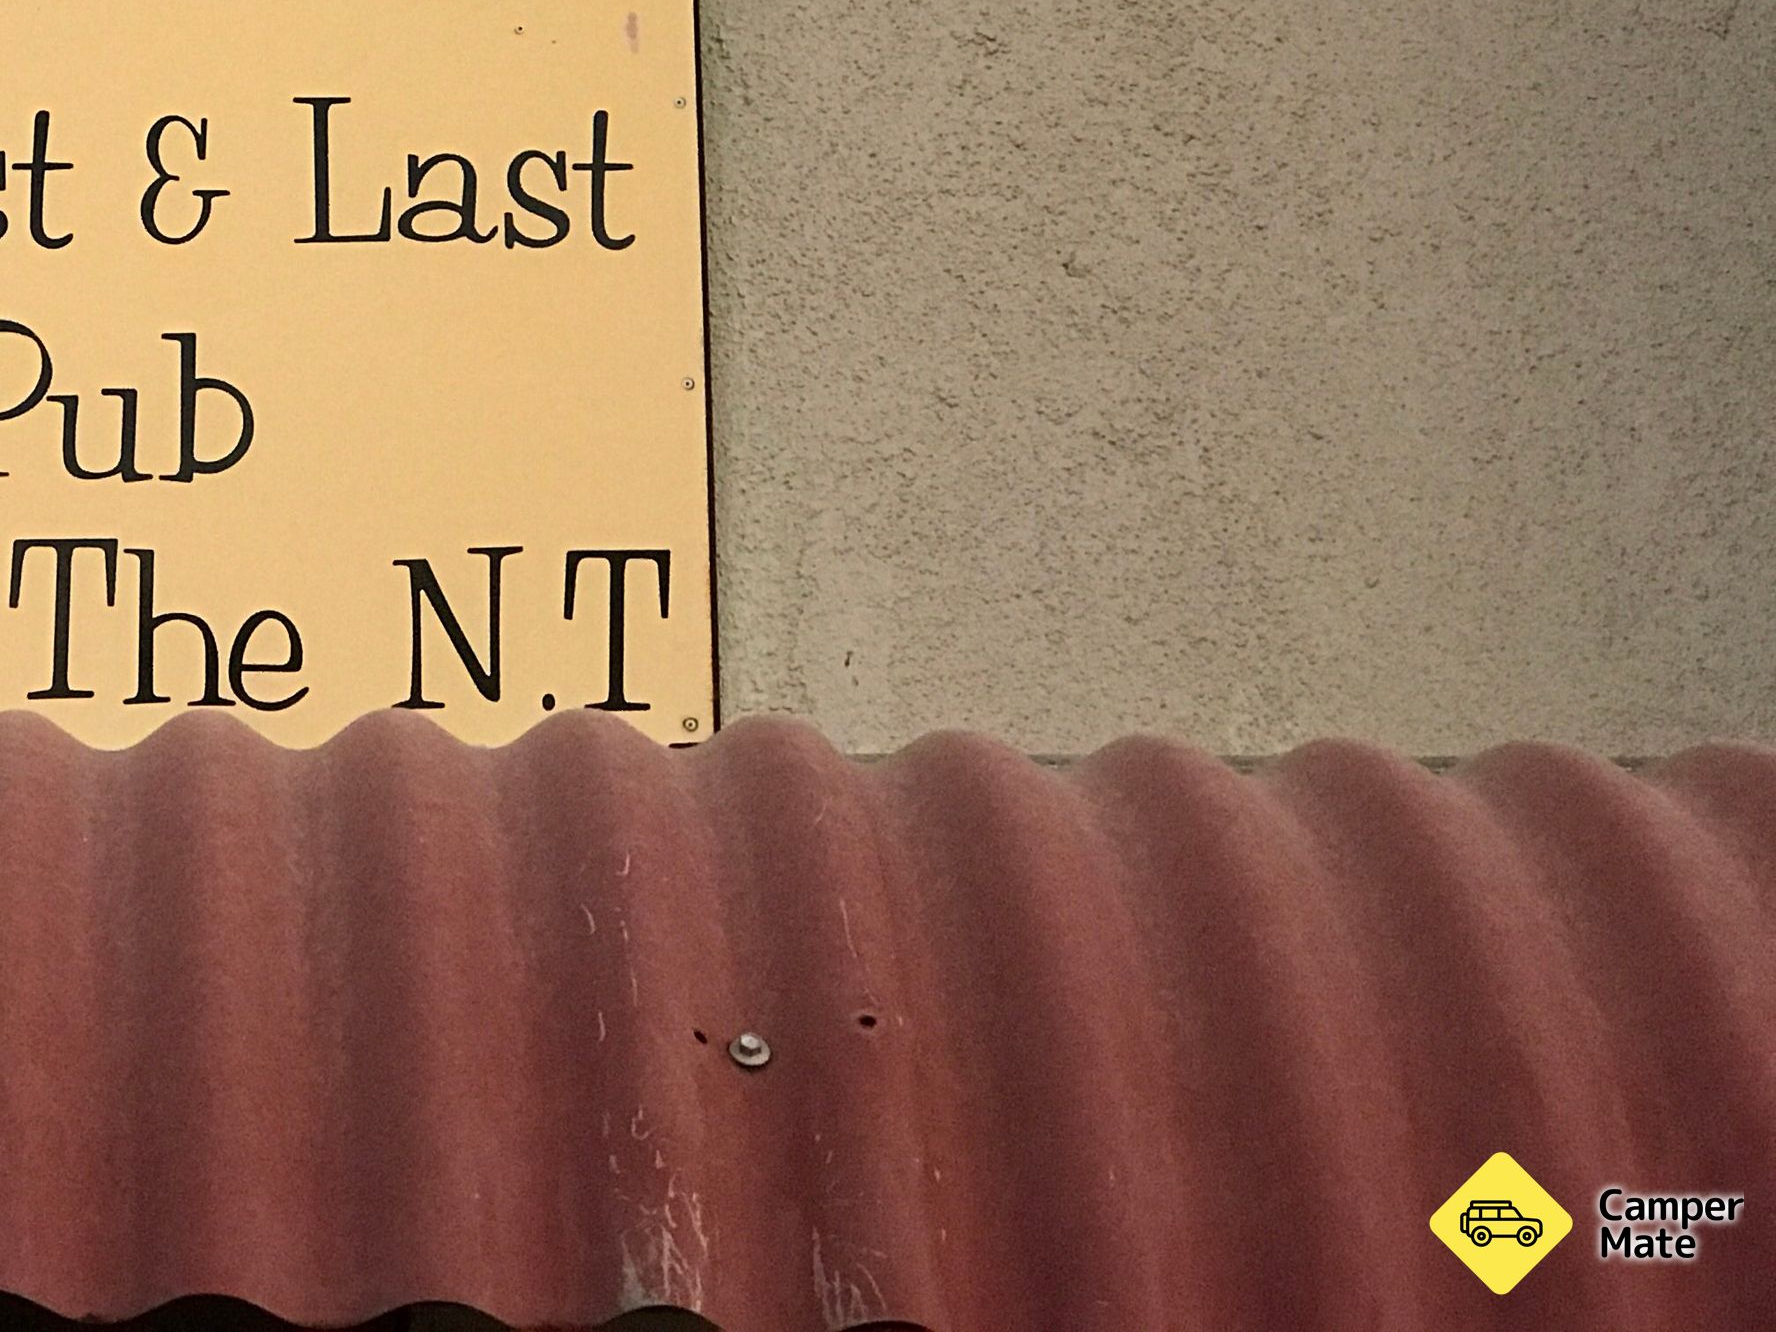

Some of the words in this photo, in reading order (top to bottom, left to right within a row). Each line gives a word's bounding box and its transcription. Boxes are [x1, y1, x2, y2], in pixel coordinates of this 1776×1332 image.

[139, 115, 231, 245] &
[292, 96, 636, 251] Last
[8, 538, 310, 712] The
